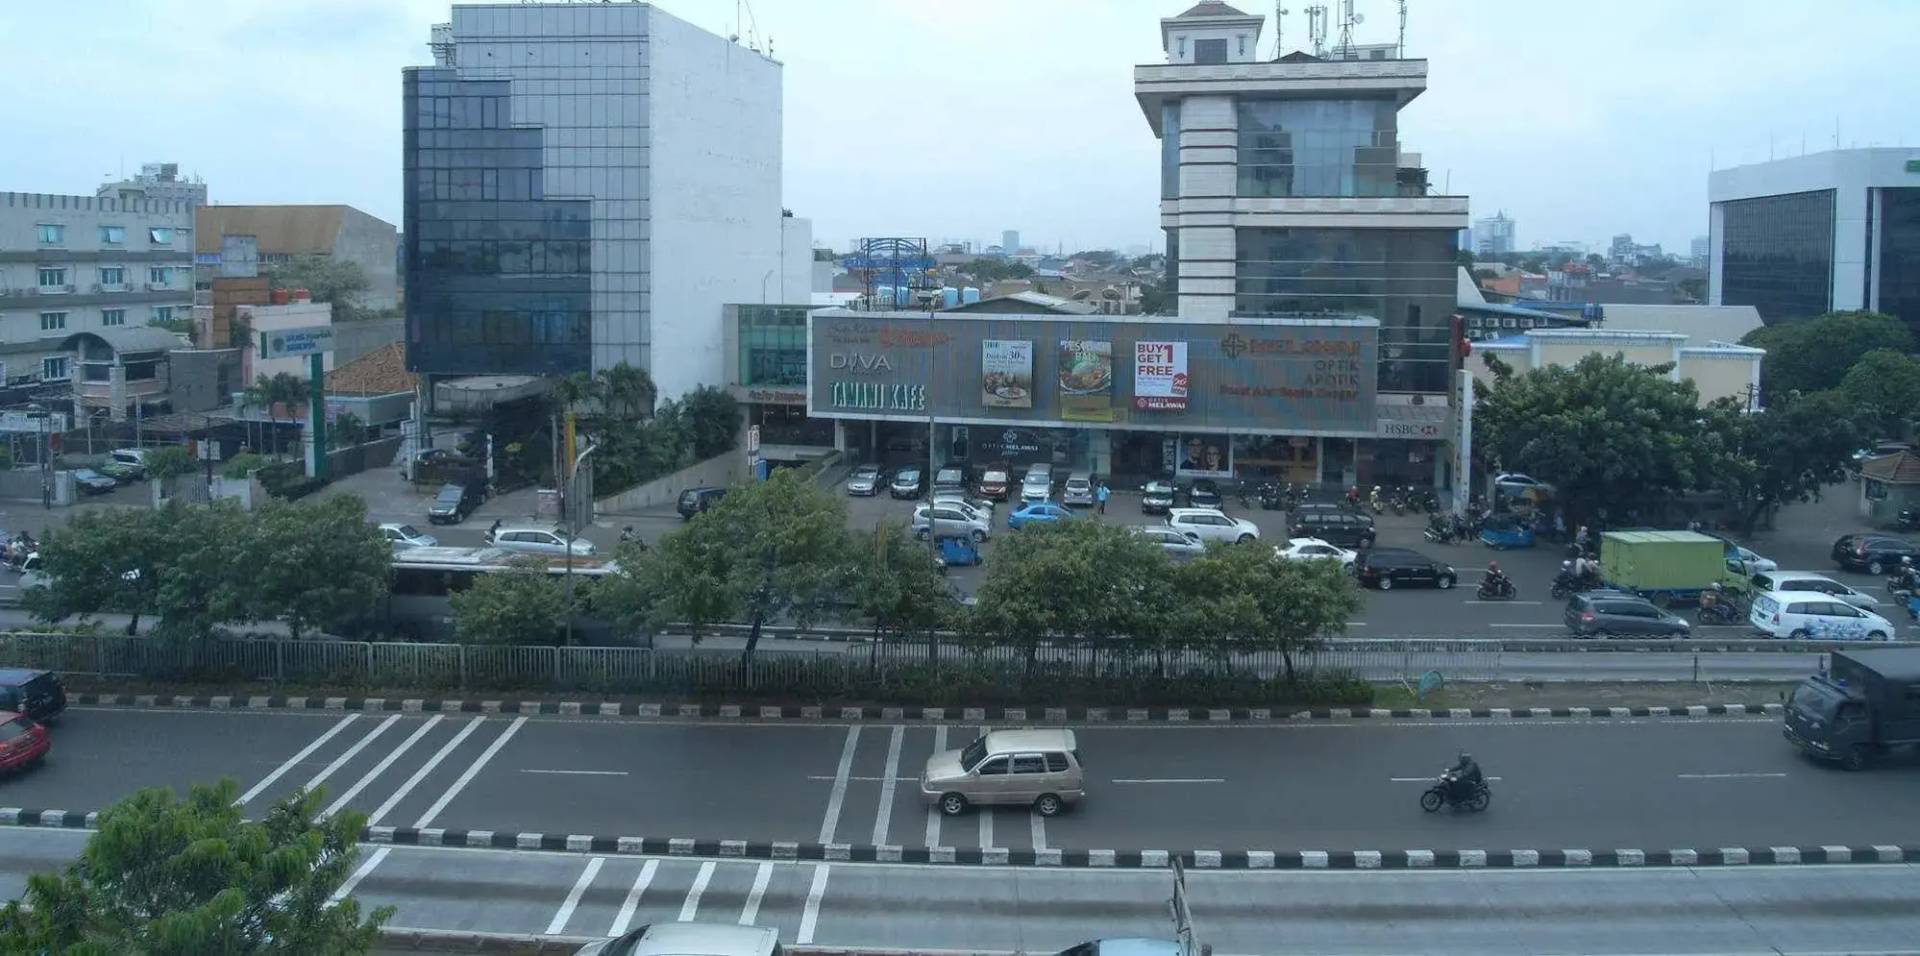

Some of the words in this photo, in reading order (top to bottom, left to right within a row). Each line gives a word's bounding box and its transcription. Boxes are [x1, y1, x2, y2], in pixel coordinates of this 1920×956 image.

[1137, 344, 1163, 353] BUY
[1164, 344, 1173, 363] 1
[1137, 354, 1162, 363] GET
[830, 353, 892, 372] DIVA
[1315, 359, 1359, 371] OPTIK
[1138, 365, 1173, 376] FREE
[1385, 424, 1418, 434] HSBC
